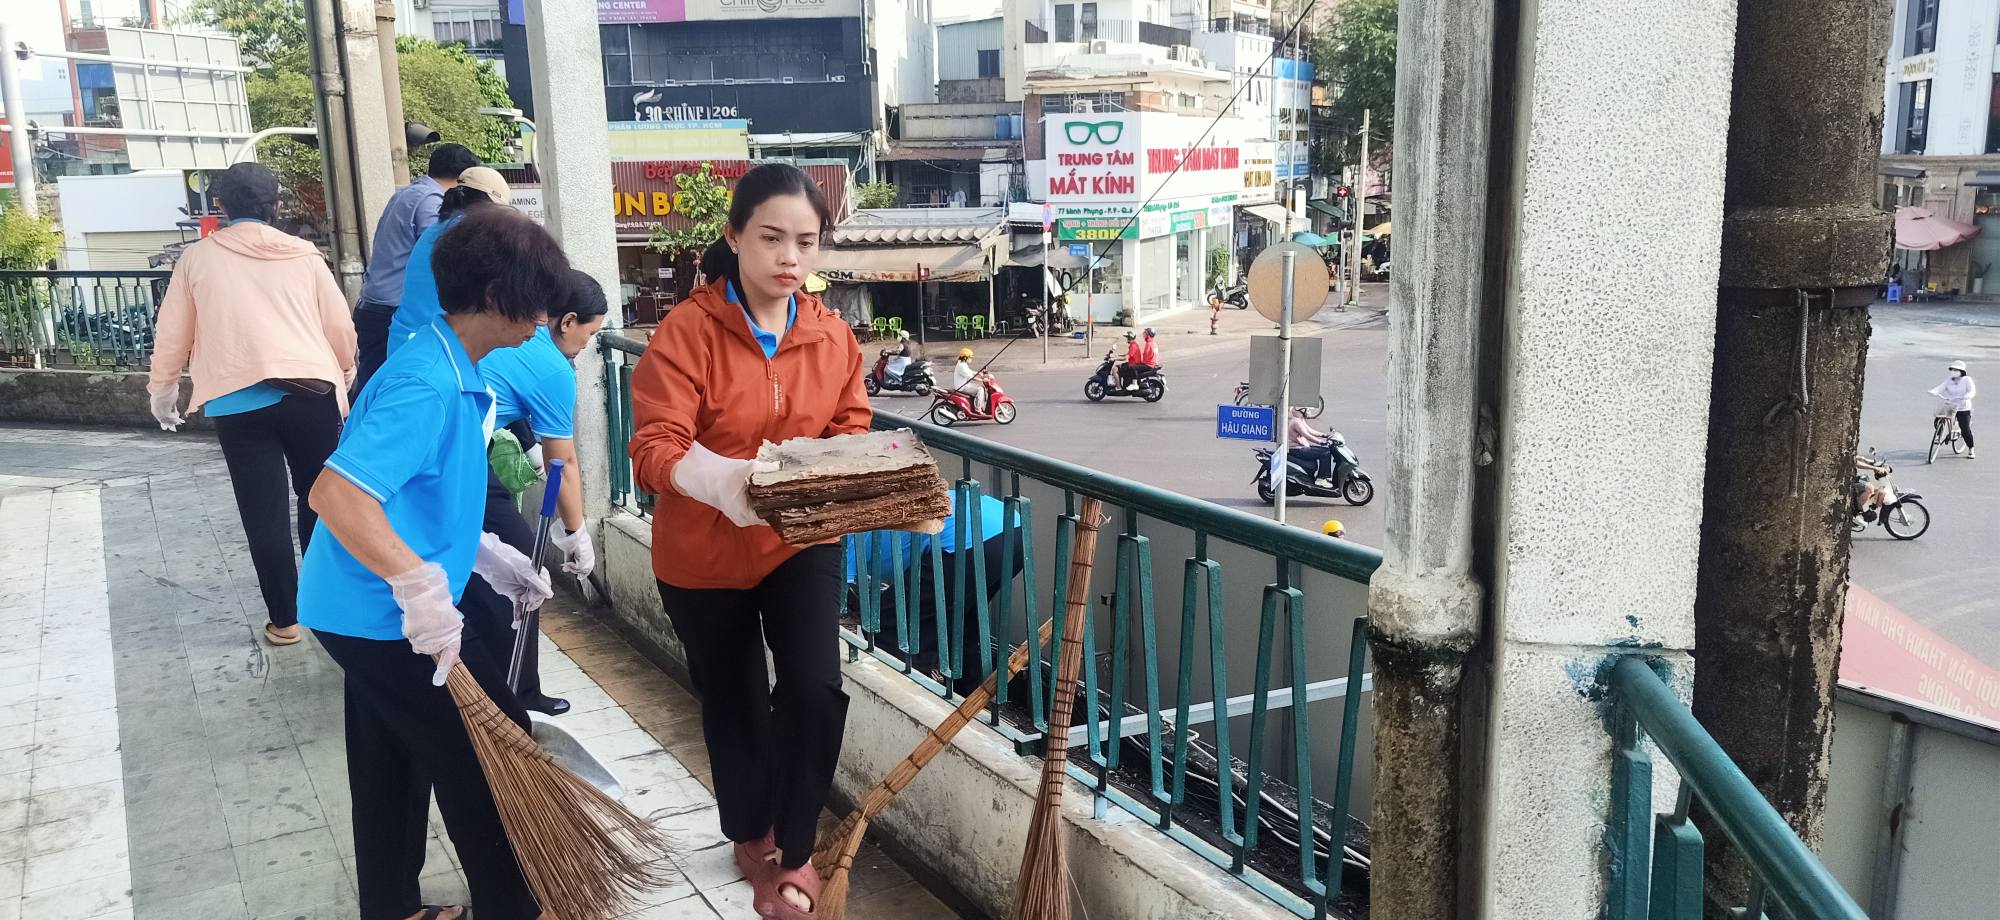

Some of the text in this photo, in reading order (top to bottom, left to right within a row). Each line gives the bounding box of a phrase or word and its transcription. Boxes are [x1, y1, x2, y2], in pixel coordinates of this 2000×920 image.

[612, 1, 647, 9] CENTER
[713, 106, 737, 117] 206
[1058, 149, 1134, 166] TRUNG TÂM
[1147, 149, 1181, 174] TRUNG
[1050, 168, 1134, 195] MẮT KÍNH
[510, 198, 537, 206] AMING
[1076, 229, 1122, 240] 380K
[1232, 408, 1260, 419] ĐƯỜNG
[1221, 421, 1268, 436] HẬU GIANG
